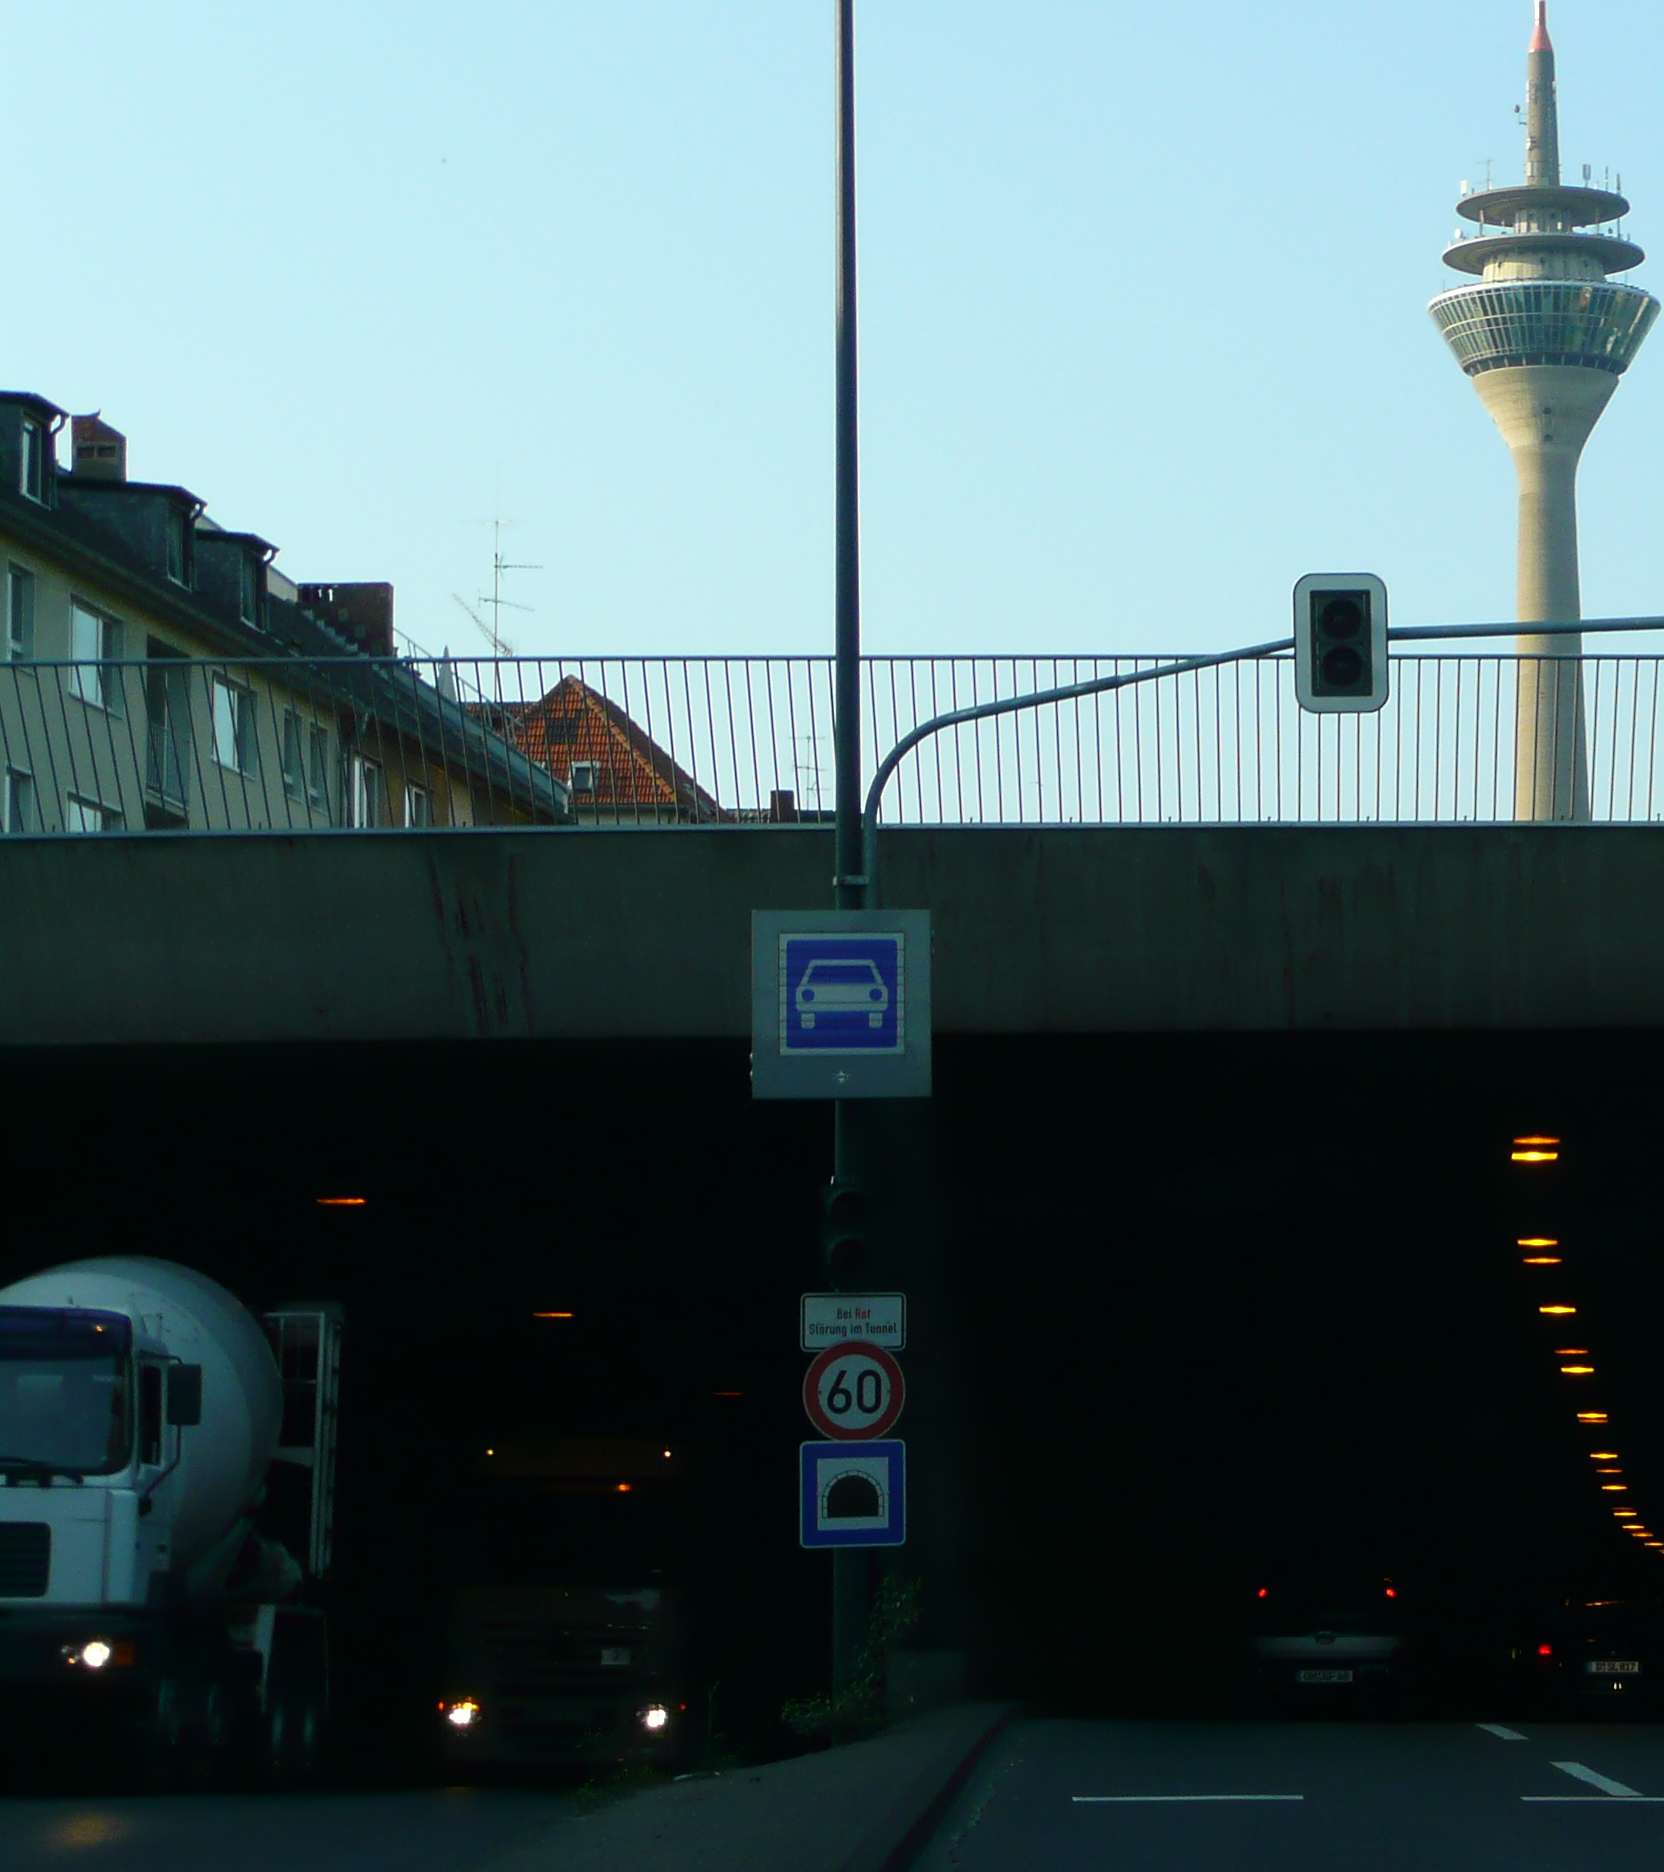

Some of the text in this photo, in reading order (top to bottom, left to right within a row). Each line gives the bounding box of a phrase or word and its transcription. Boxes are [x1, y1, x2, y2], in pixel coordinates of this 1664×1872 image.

[836, 1308, 871, 1319] Bei Rot
[809, 1322, 897, 1337] Störung im Tunnel
[827, 1368, 882, 1415] 60
